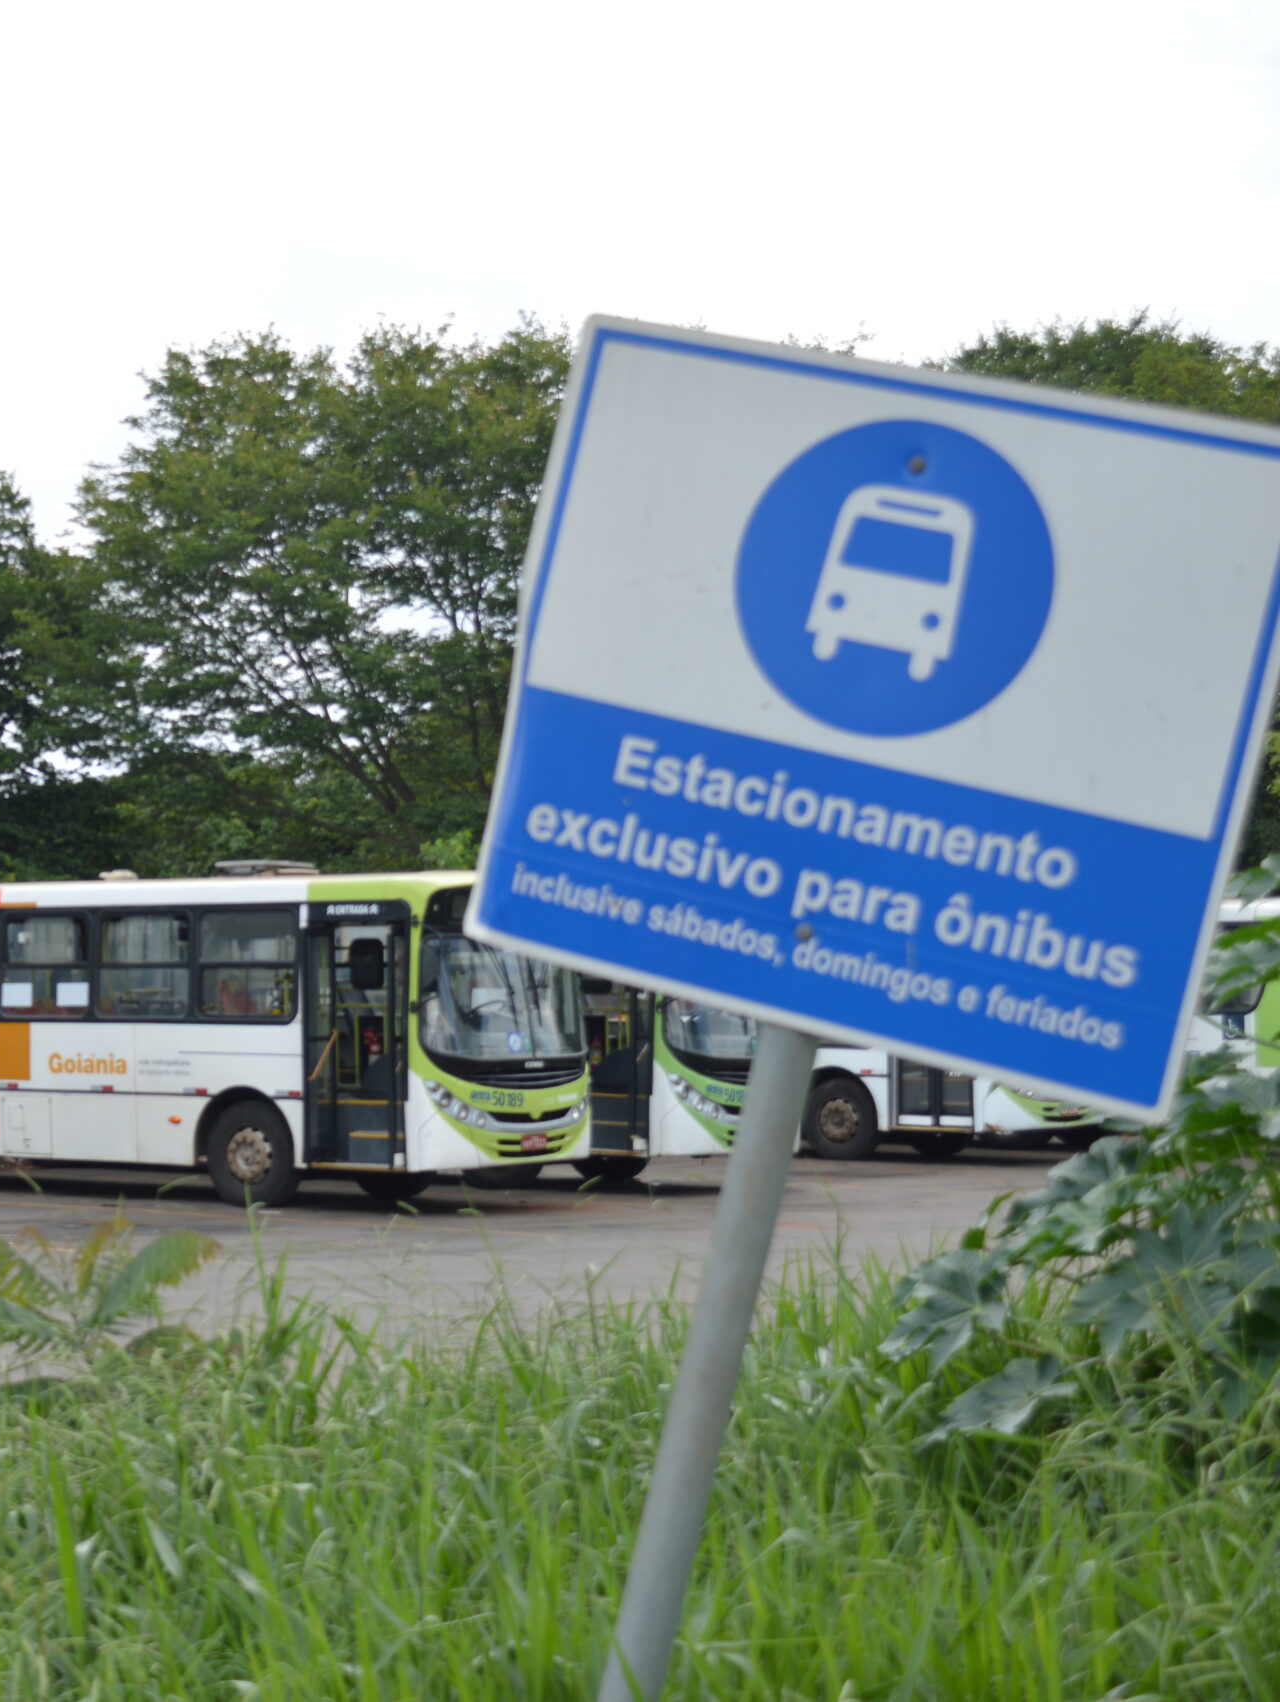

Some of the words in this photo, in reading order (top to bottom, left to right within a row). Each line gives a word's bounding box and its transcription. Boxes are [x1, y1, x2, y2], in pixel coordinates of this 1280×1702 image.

[525, 802, 782, 898] exclusivo
[790, 868, 922, 935] para
[934, 892, 1138, 988] ônibus
[613, 735, 1078, 889] Estacionamento
[511, 862, 644, 925] inclusive
[646, 903, 785, 966] sábados,
[791, 934, 952, 1006] domingos
[956, 985, 981, 1013] e
[985, 984, 1123, 1050] feriados
